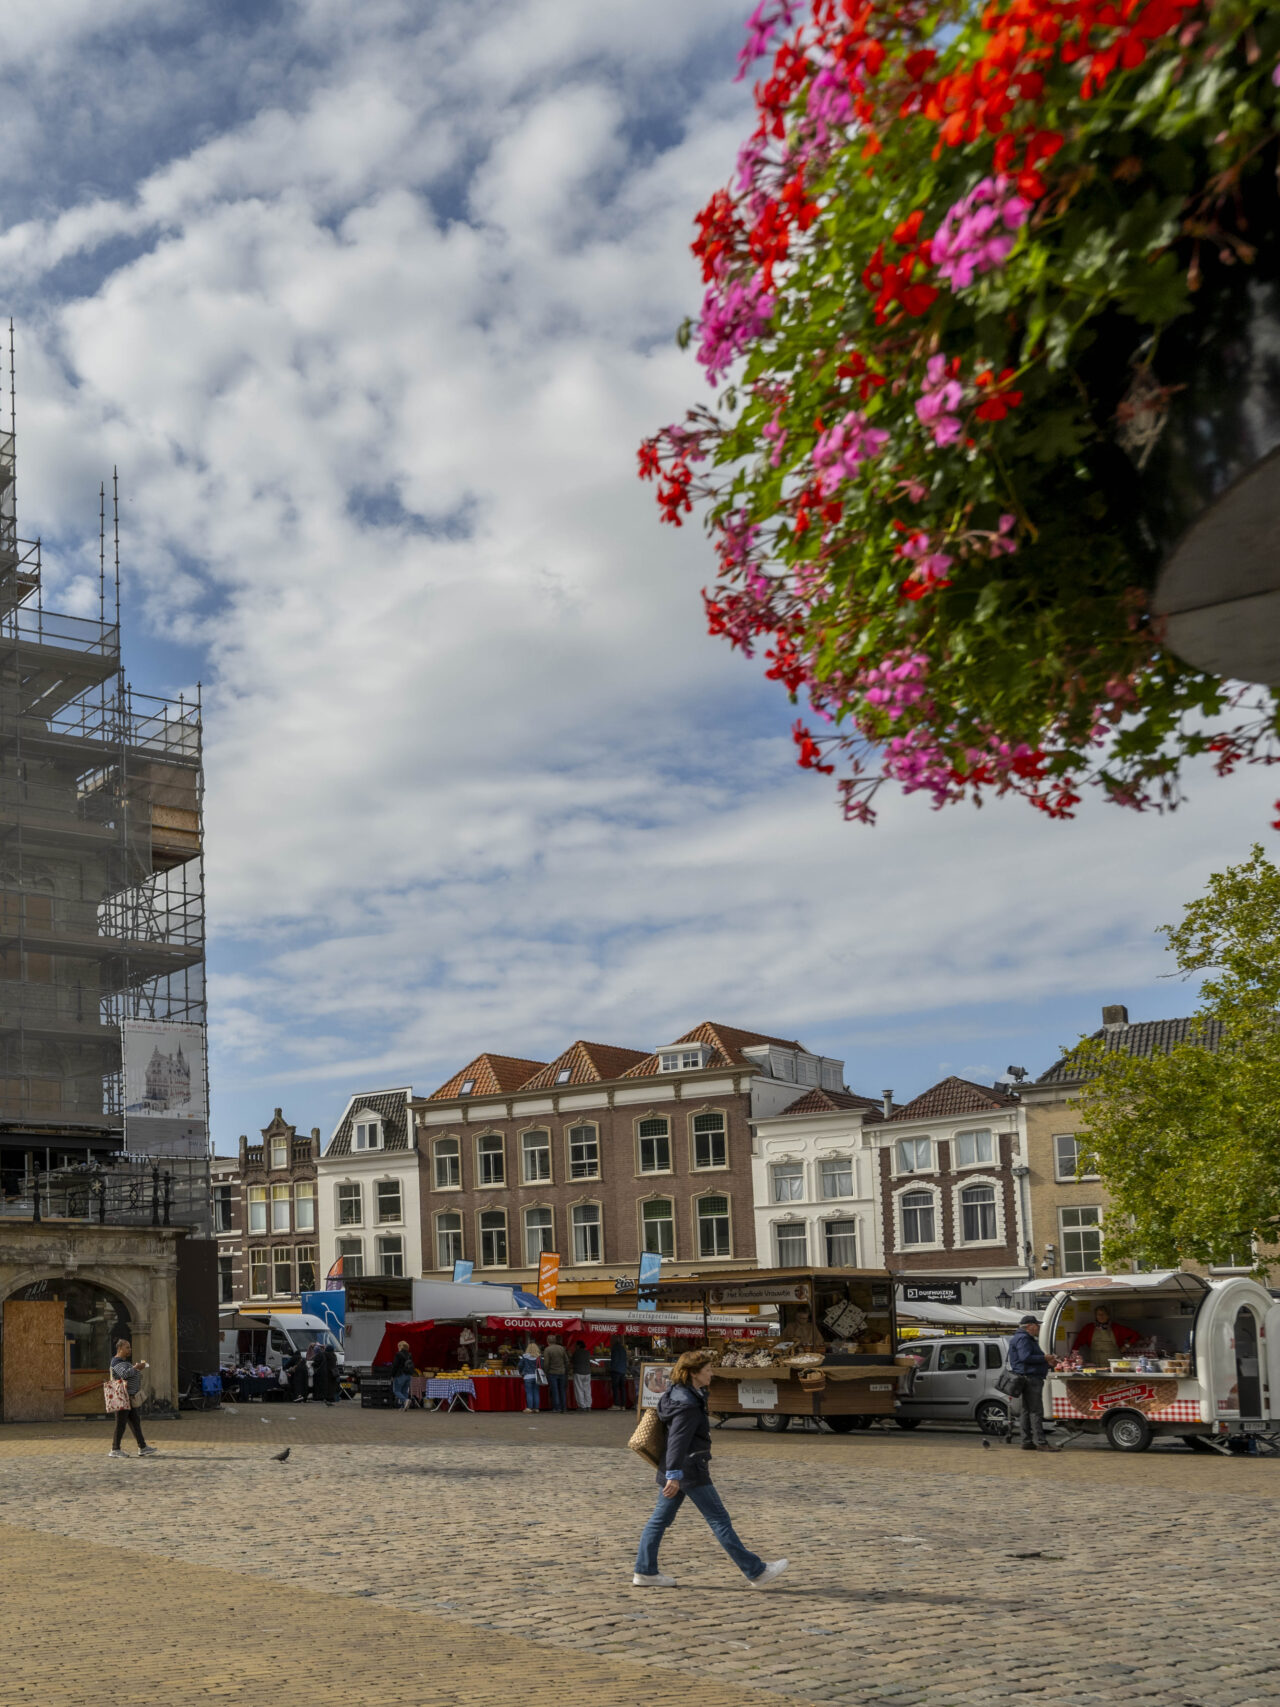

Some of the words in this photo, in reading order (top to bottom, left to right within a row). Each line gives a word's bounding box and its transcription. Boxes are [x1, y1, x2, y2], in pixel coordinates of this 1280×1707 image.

[504, 1319, 537, 1328] GOUDA
[538, 1320, 564, 1328] KAAS
[591, 1324, 618, 1332] FROMAGE
[625, 1324, 640, 1333] KÄSE
[647, 1326, 668, 1334] CHEESE
